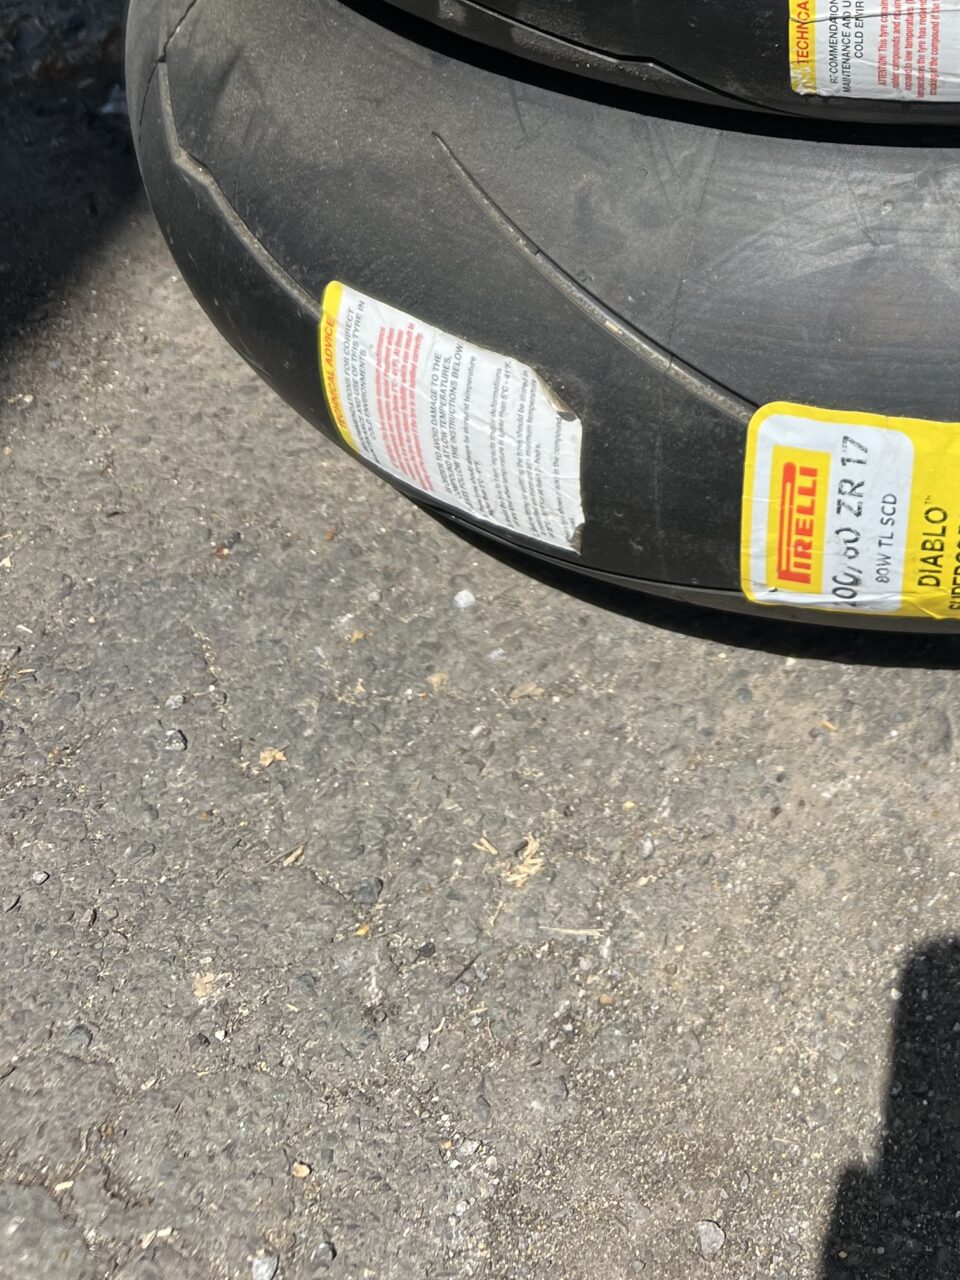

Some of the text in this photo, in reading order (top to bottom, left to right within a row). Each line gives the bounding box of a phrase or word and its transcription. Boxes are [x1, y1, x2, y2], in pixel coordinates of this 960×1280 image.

[855, 32, 864, 58] COLD
[878, 39, 888, 52] This
[880, 24, 889, 36] tyre
[892, 22, 900, 34] and
[930, 22, 940, 55] compound
[344, 308, 354, 355] CORRECT
[352, 300, 365, 376] OF TYRE IN
[324, 318, 346, 430] TECHNICAL ADVICE
[360, 350, 371, 418] ENVIRONMENTS
[430, 354, 441, 426] DAMAGE TO THE
[440, 356, 452, 430] TEMPERATURES,
[449, 381, 457, 444] INSTRUCTIONS
[840, 436, 868, 466] 17
[777, 462, 817, 584] PIRELLI
[836, 478, 864, 518] ZR
[874, 494, 897, 583] 80W TL SCD
